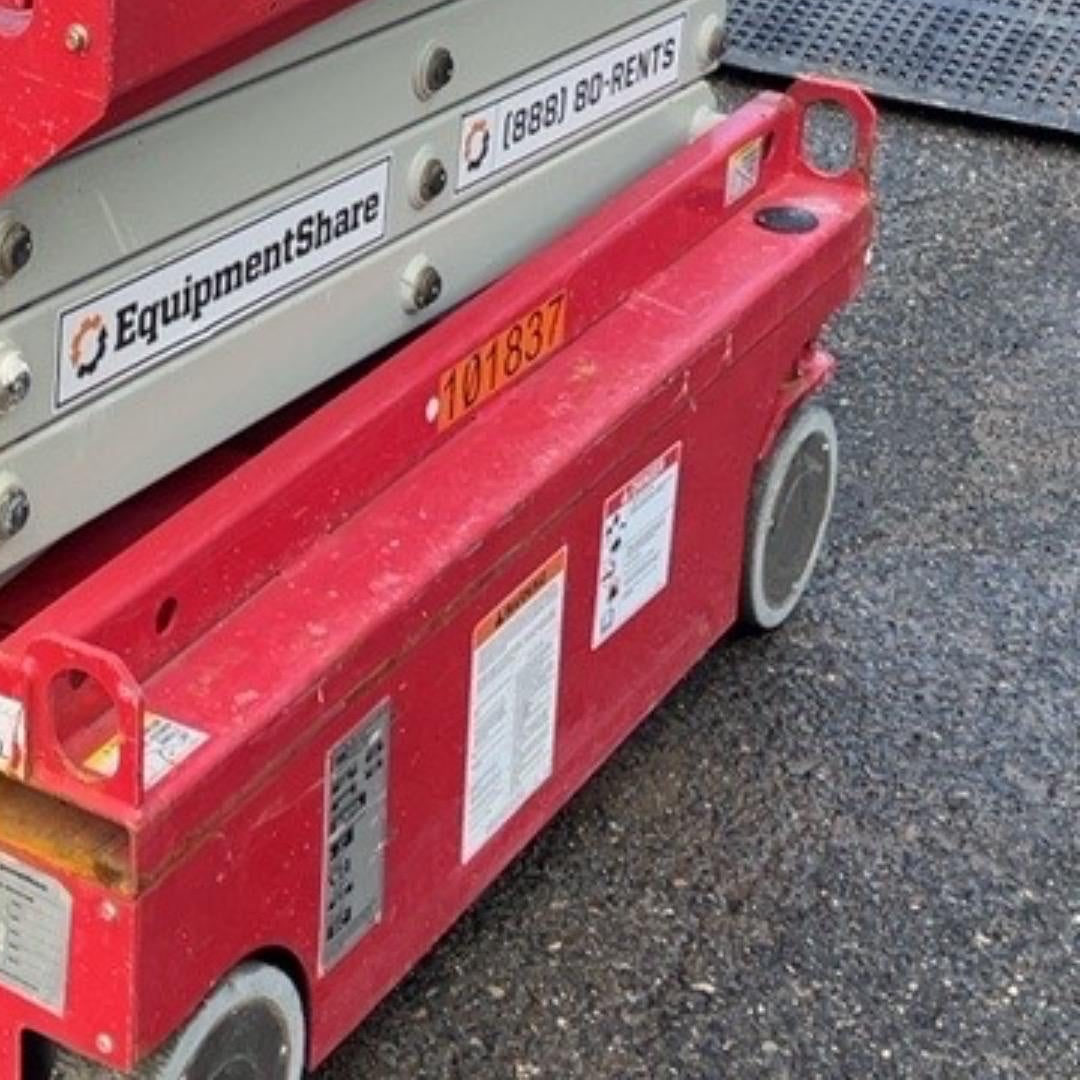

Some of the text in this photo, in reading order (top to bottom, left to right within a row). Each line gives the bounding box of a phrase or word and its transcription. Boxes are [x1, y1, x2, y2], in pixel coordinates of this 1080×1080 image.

[574, 37, 675, 113] 80-RENTS
[114, 192, 379, 351] EquipmentShare
[443, 293, 565, 420] 101837
